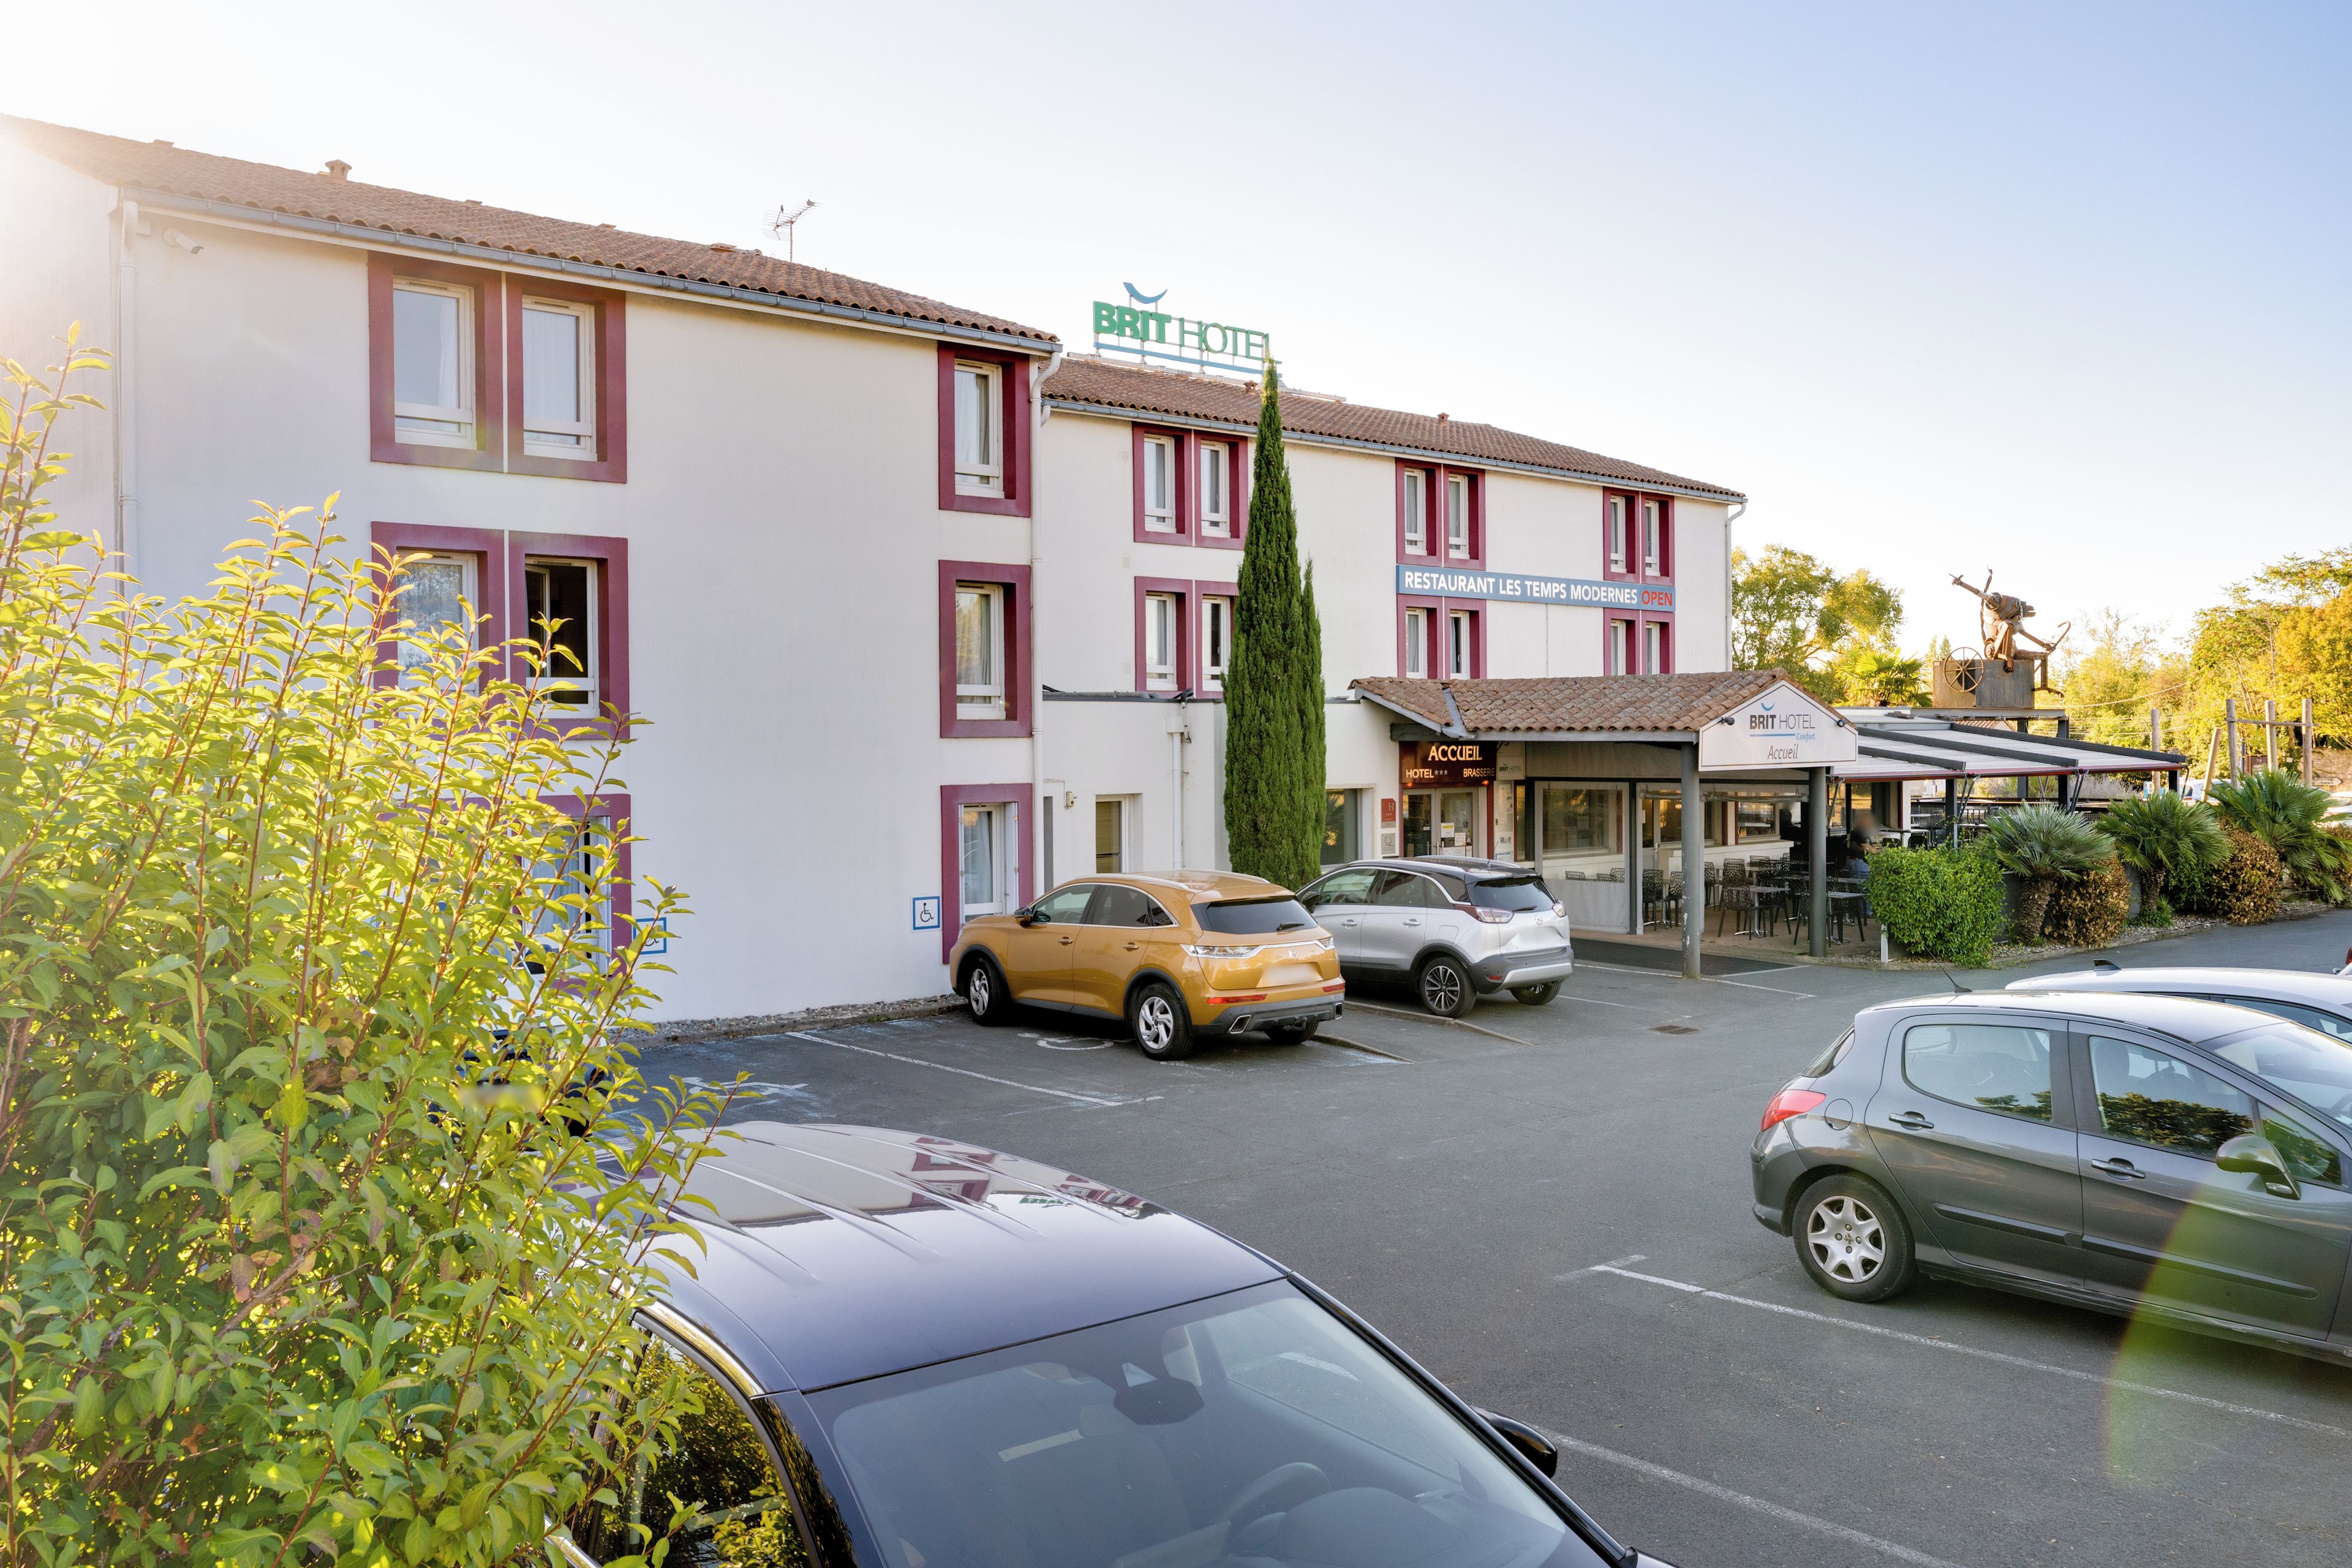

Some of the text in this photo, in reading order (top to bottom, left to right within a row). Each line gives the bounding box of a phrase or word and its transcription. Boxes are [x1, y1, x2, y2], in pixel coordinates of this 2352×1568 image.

[1093, 301, 1282, 364] BRIT HOTEL
[1404, 571, 1673, 606] RESTAURANT LES TEMPS MODERNES OPEN
[1750, 714, 1815, 729] BRIT HOTEL
[1796, 733, 1815, 742] Confort
[1428, 745, 1482, 761] ACCUEIL
[1768, 744, 1798, 760] Accueil
[1406, 768, 1495, 778] HOTEL BRASSERIE
